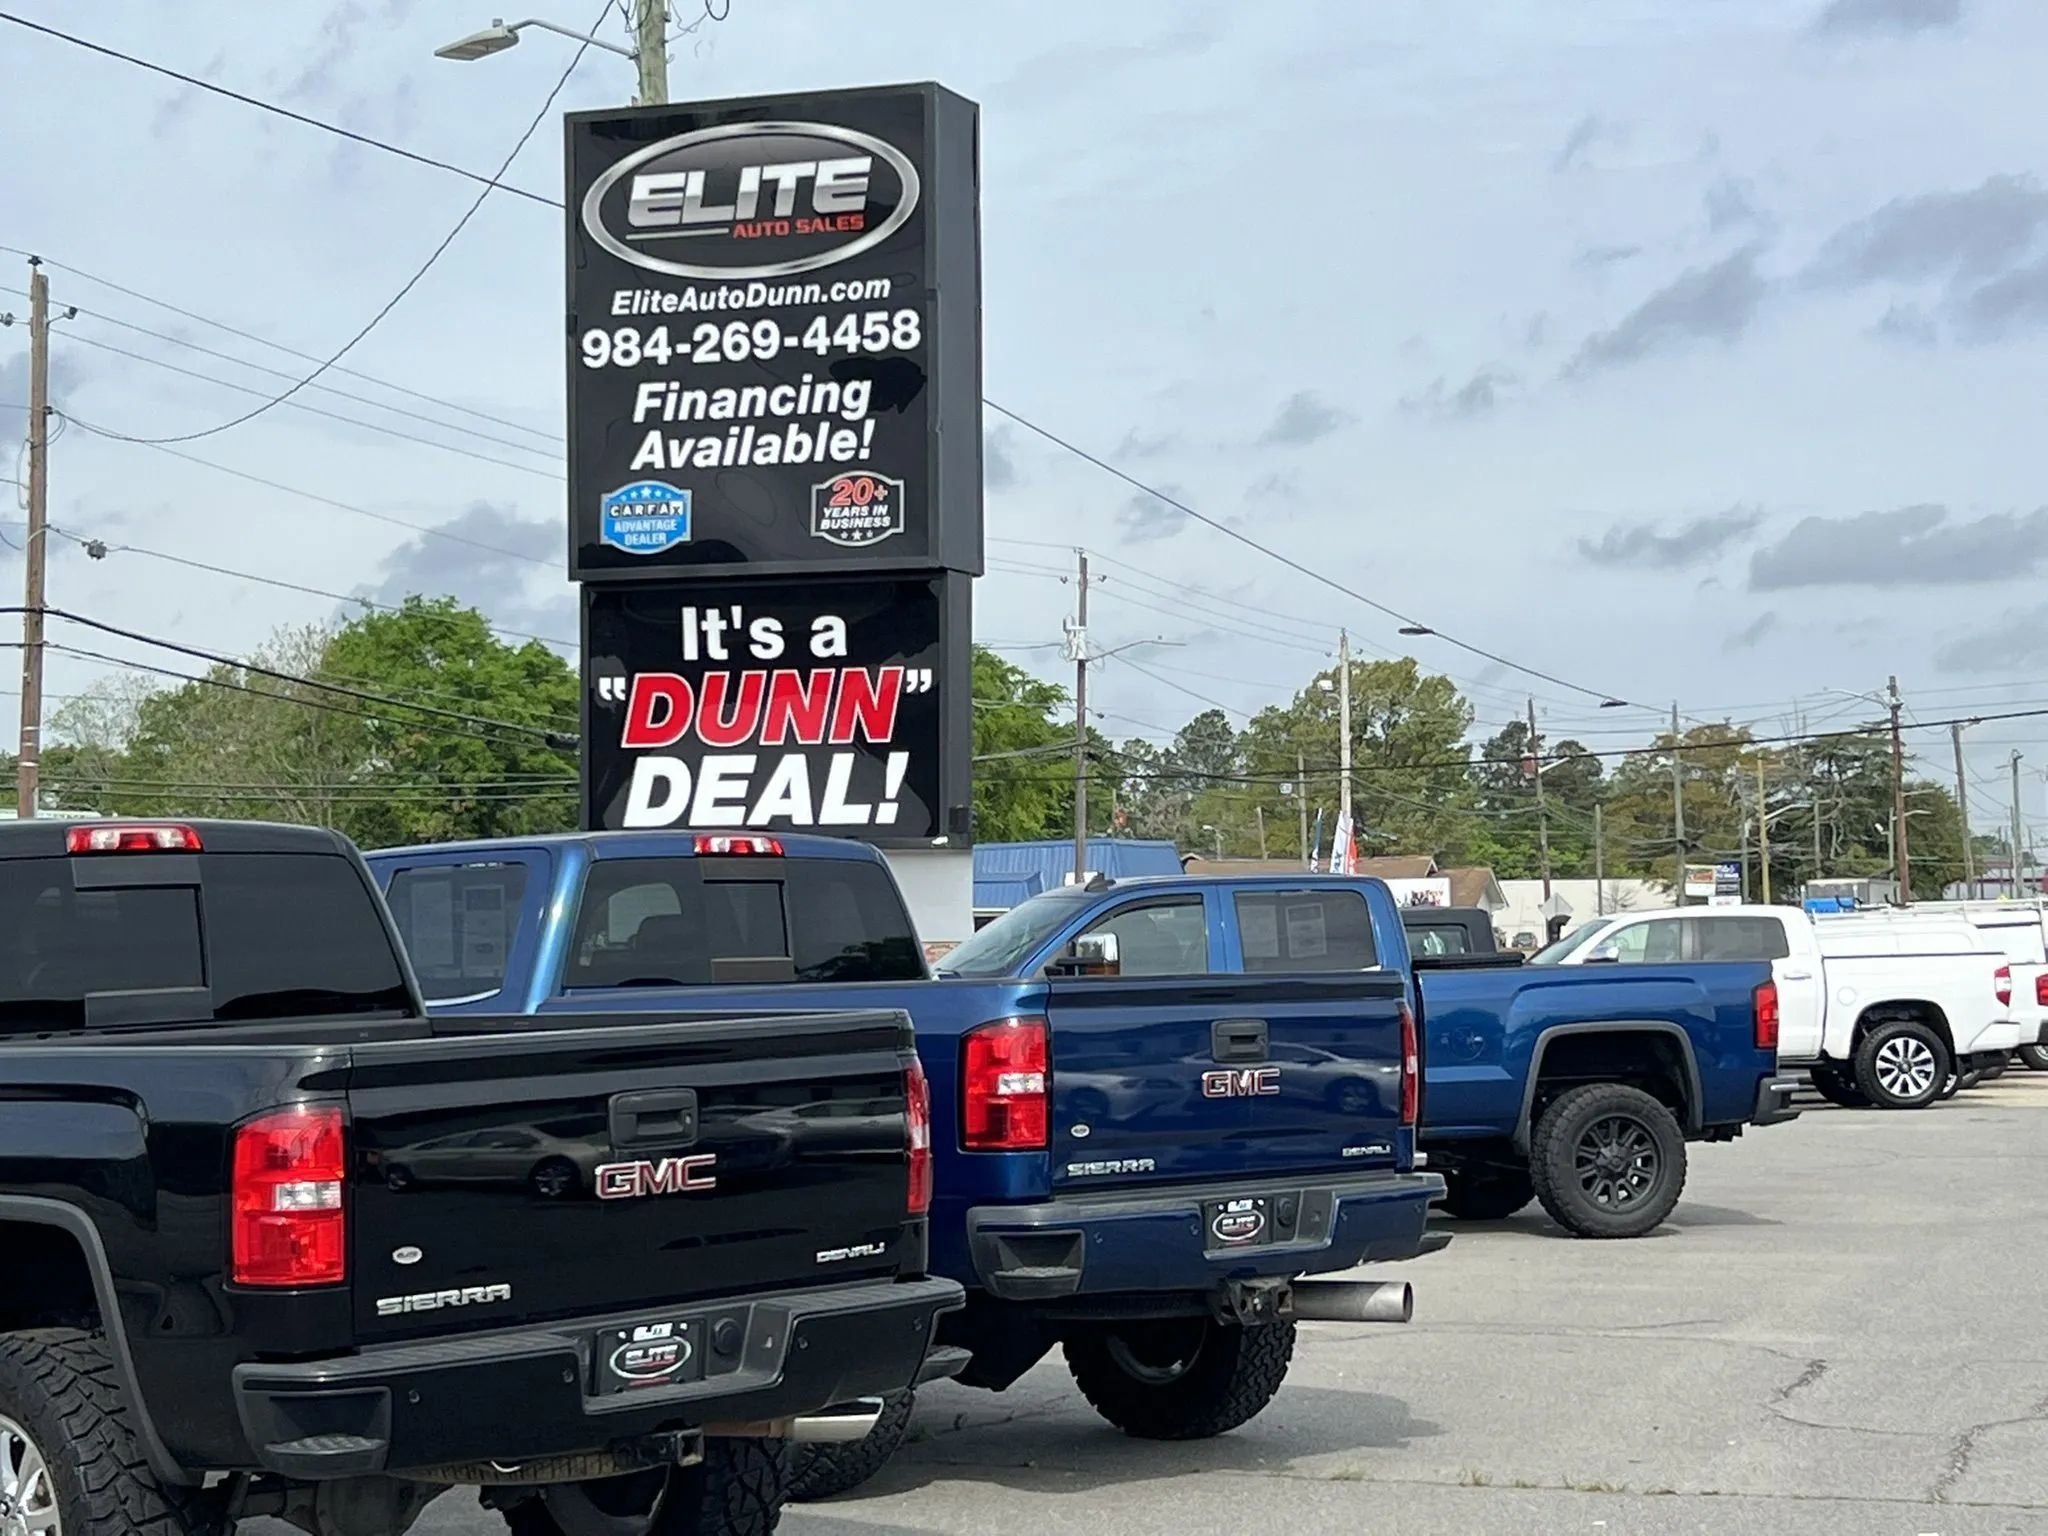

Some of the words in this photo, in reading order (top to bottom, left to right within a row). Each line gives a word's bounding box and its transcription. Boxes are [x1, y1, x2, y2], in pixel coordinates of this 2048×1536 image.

[628, 156, 873, 227] ELITE
[732, 222, 790, 239] AUTO
[795, 214, 865, 234] SALES
[611, 277, 892, 316] EliteAutoDunn.com
[582, 309, 922, 369] 984-269-4458
[632, 373, 872, 423] Financing
[630, 419, 875, 470] Available!
[829, 477, 889, 506] 20+
[609, 501, 684, 517] CARFAX
[820, 516, 891, 530] BUSINESS
[823, 505, 870, 518] YEARS
[872, 504, 889, 516] IN
[614, 518, 678, 533] ADVANTAGE
[624, 532, 667, 546] DEALER
[681, 605, 785, 661] It's
[809, 615, 848, 657] a
[622, 751, 910, 828] DEAL!
[1201, 1068, 1280, 1098] GMC
[594, 1153, 717, 1199] GMC
[1067, 1158, 1155, 1177] SIERRA
[816, 1241, 886, 1263] DENALI
[376, 1283, 511, 1316] SIERRA
